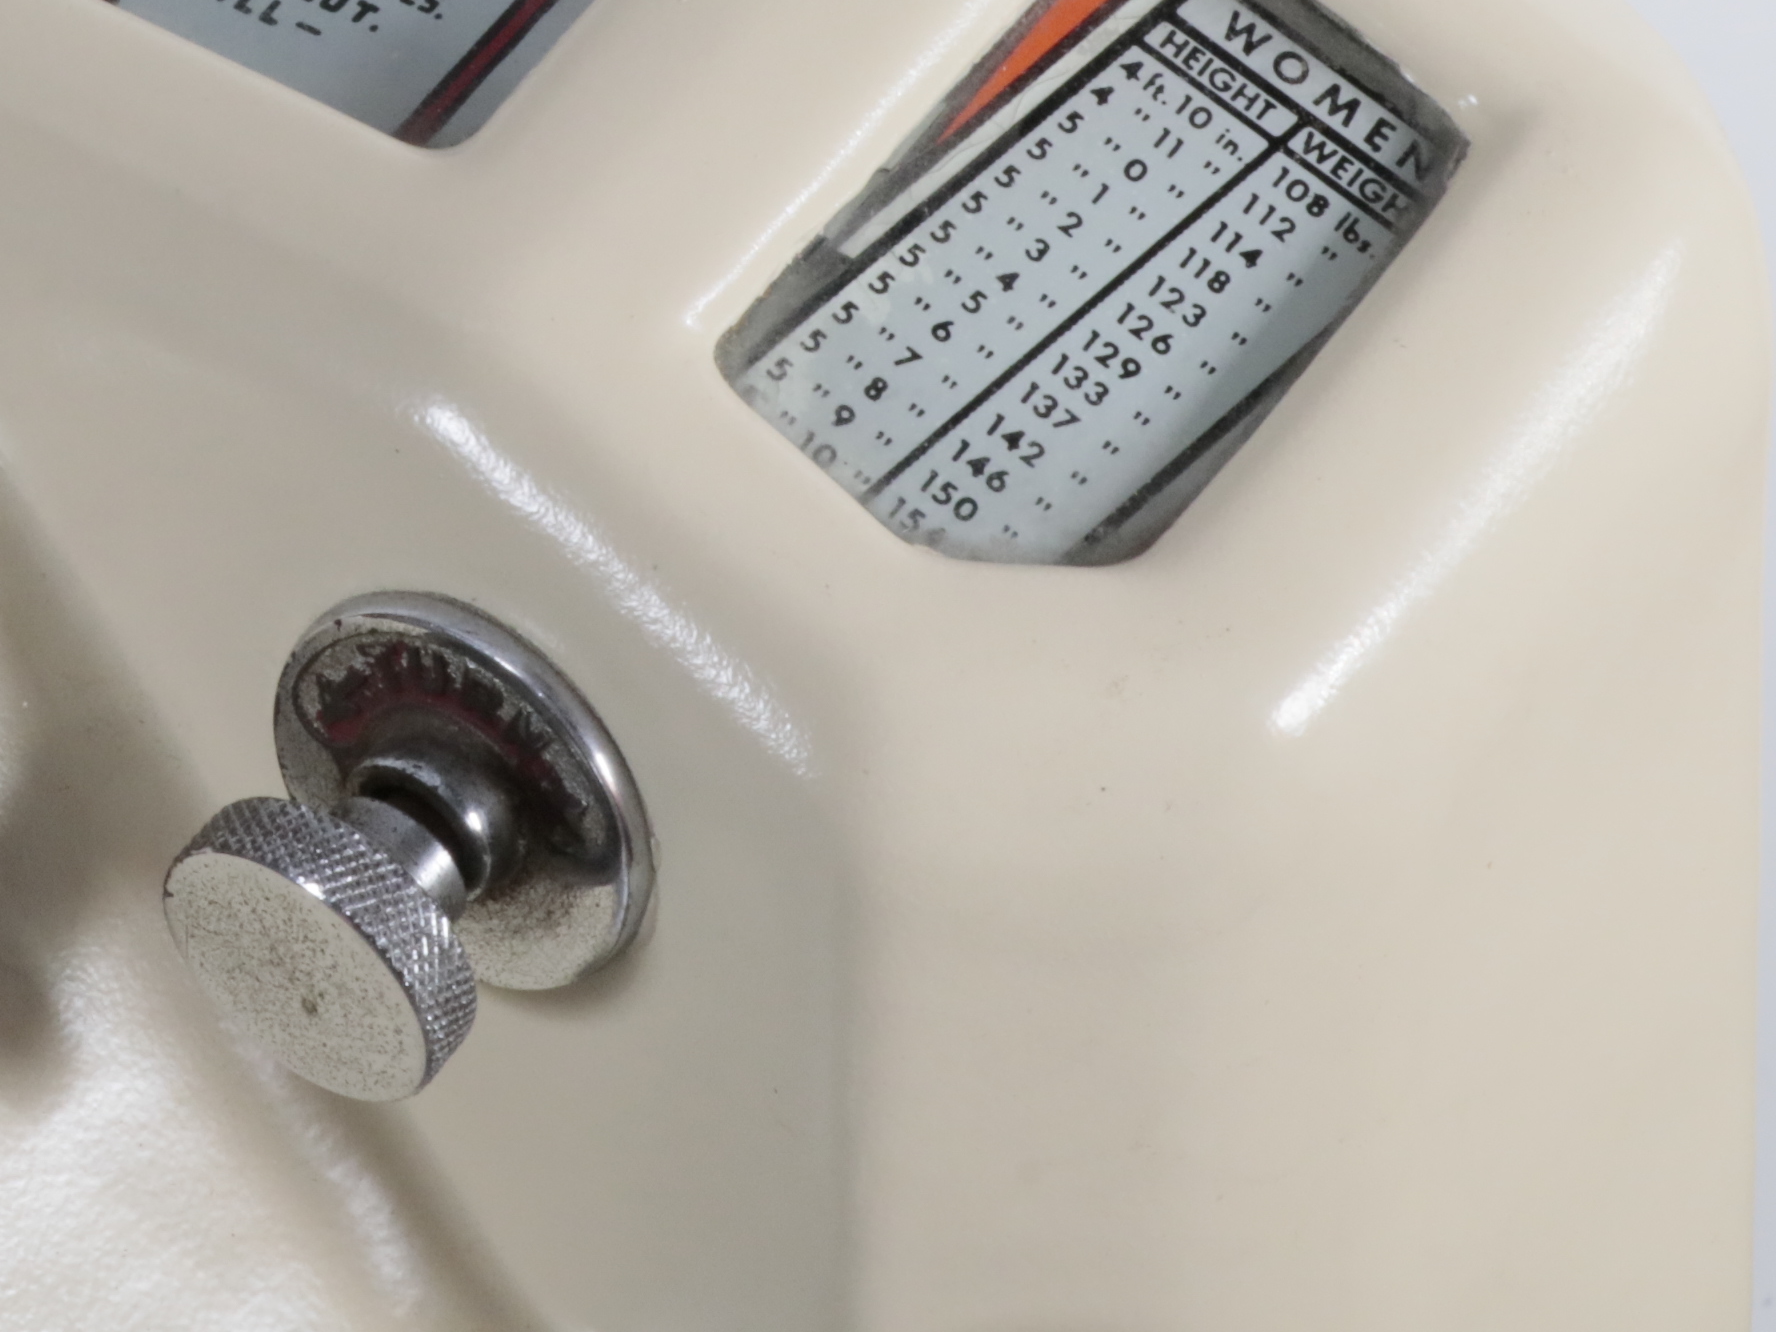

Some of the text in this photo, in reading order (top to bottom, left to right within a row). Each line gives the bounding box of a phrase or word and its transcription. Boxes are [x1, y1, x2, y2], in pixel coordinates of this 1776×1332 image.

[1119, 60, 1144, 83] 4
[1143, 72, 1168, 106] ft.
[1175, 94, 1213, 130] 10
[1215, 128, 1244, 161] in.
[1272, 166, 1330, 218] 108
[1159, 29, 1277, 121] HEIGHT
[1026, 137, 1231, 294] 5 1 118
[1057, 111, 1263, 268] 5 0 114
[1089, 85, 1296, 243] 4 11 112
[899, 243, 1110, 407] 5 5 133
[930, 220, 1142, 380] 5 4 129
[961, 191, 1176, 355] 5 3 126
[994, 165, 1207, 328] 5 2 123
[800, 329, 1010, 493] 5 8 146
[831, 301, 1046, 468] 5 7 142
[868, 271, 1082, 429] 5 6 137
[766, 356, 979, 522] 5 9 150
